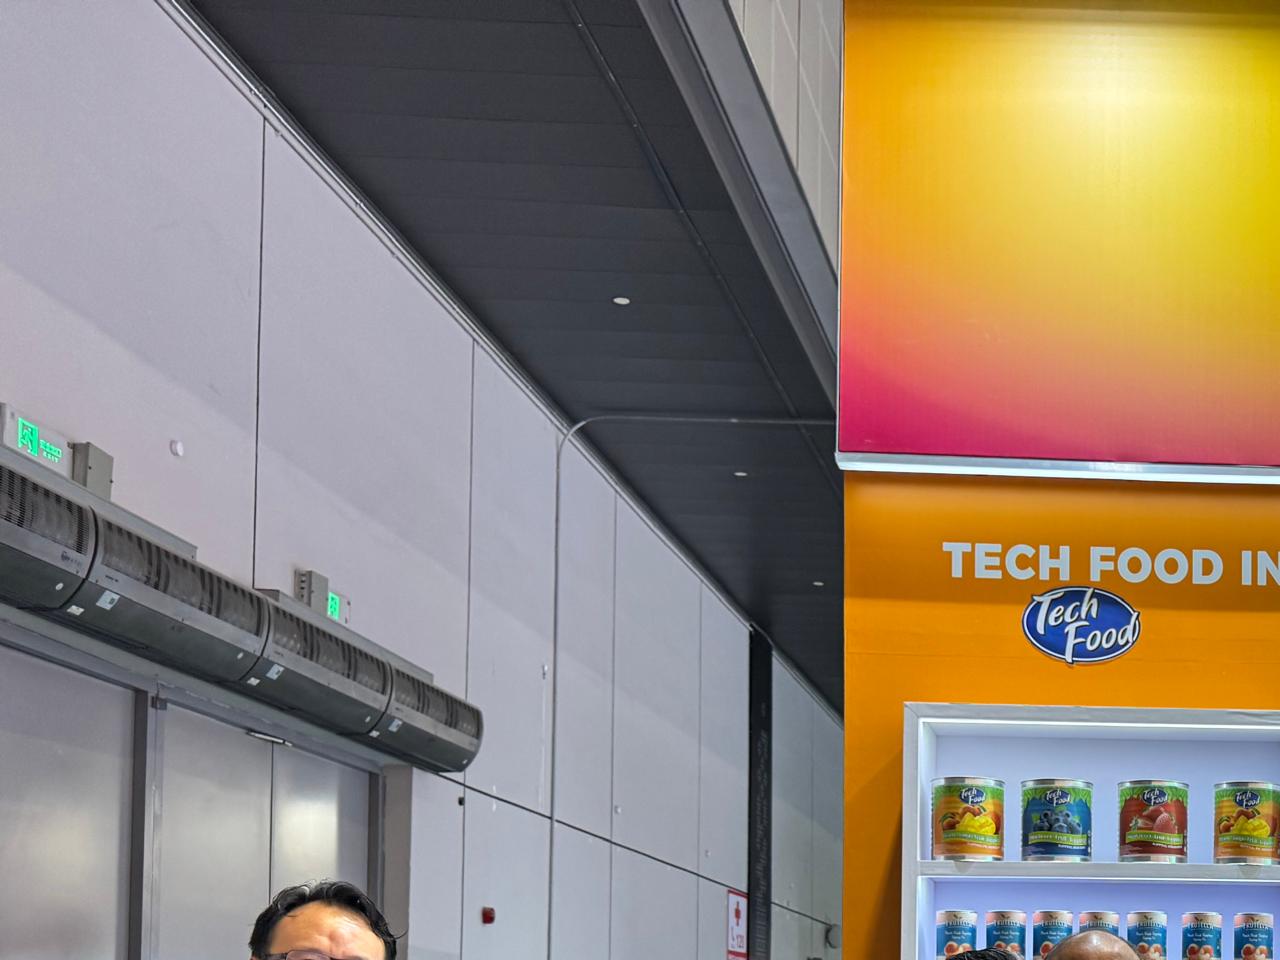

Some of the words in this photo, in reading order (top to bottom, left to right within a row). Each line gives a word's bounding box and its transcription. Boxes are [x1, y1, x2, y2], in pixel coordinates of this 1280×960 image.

[943, 542, 1070, 581] TECH
[1090, 546, 1223, 585] FOOD
[1033, 588, 1098, 634] Tech
[1064, 612, 1140, 664] Food
